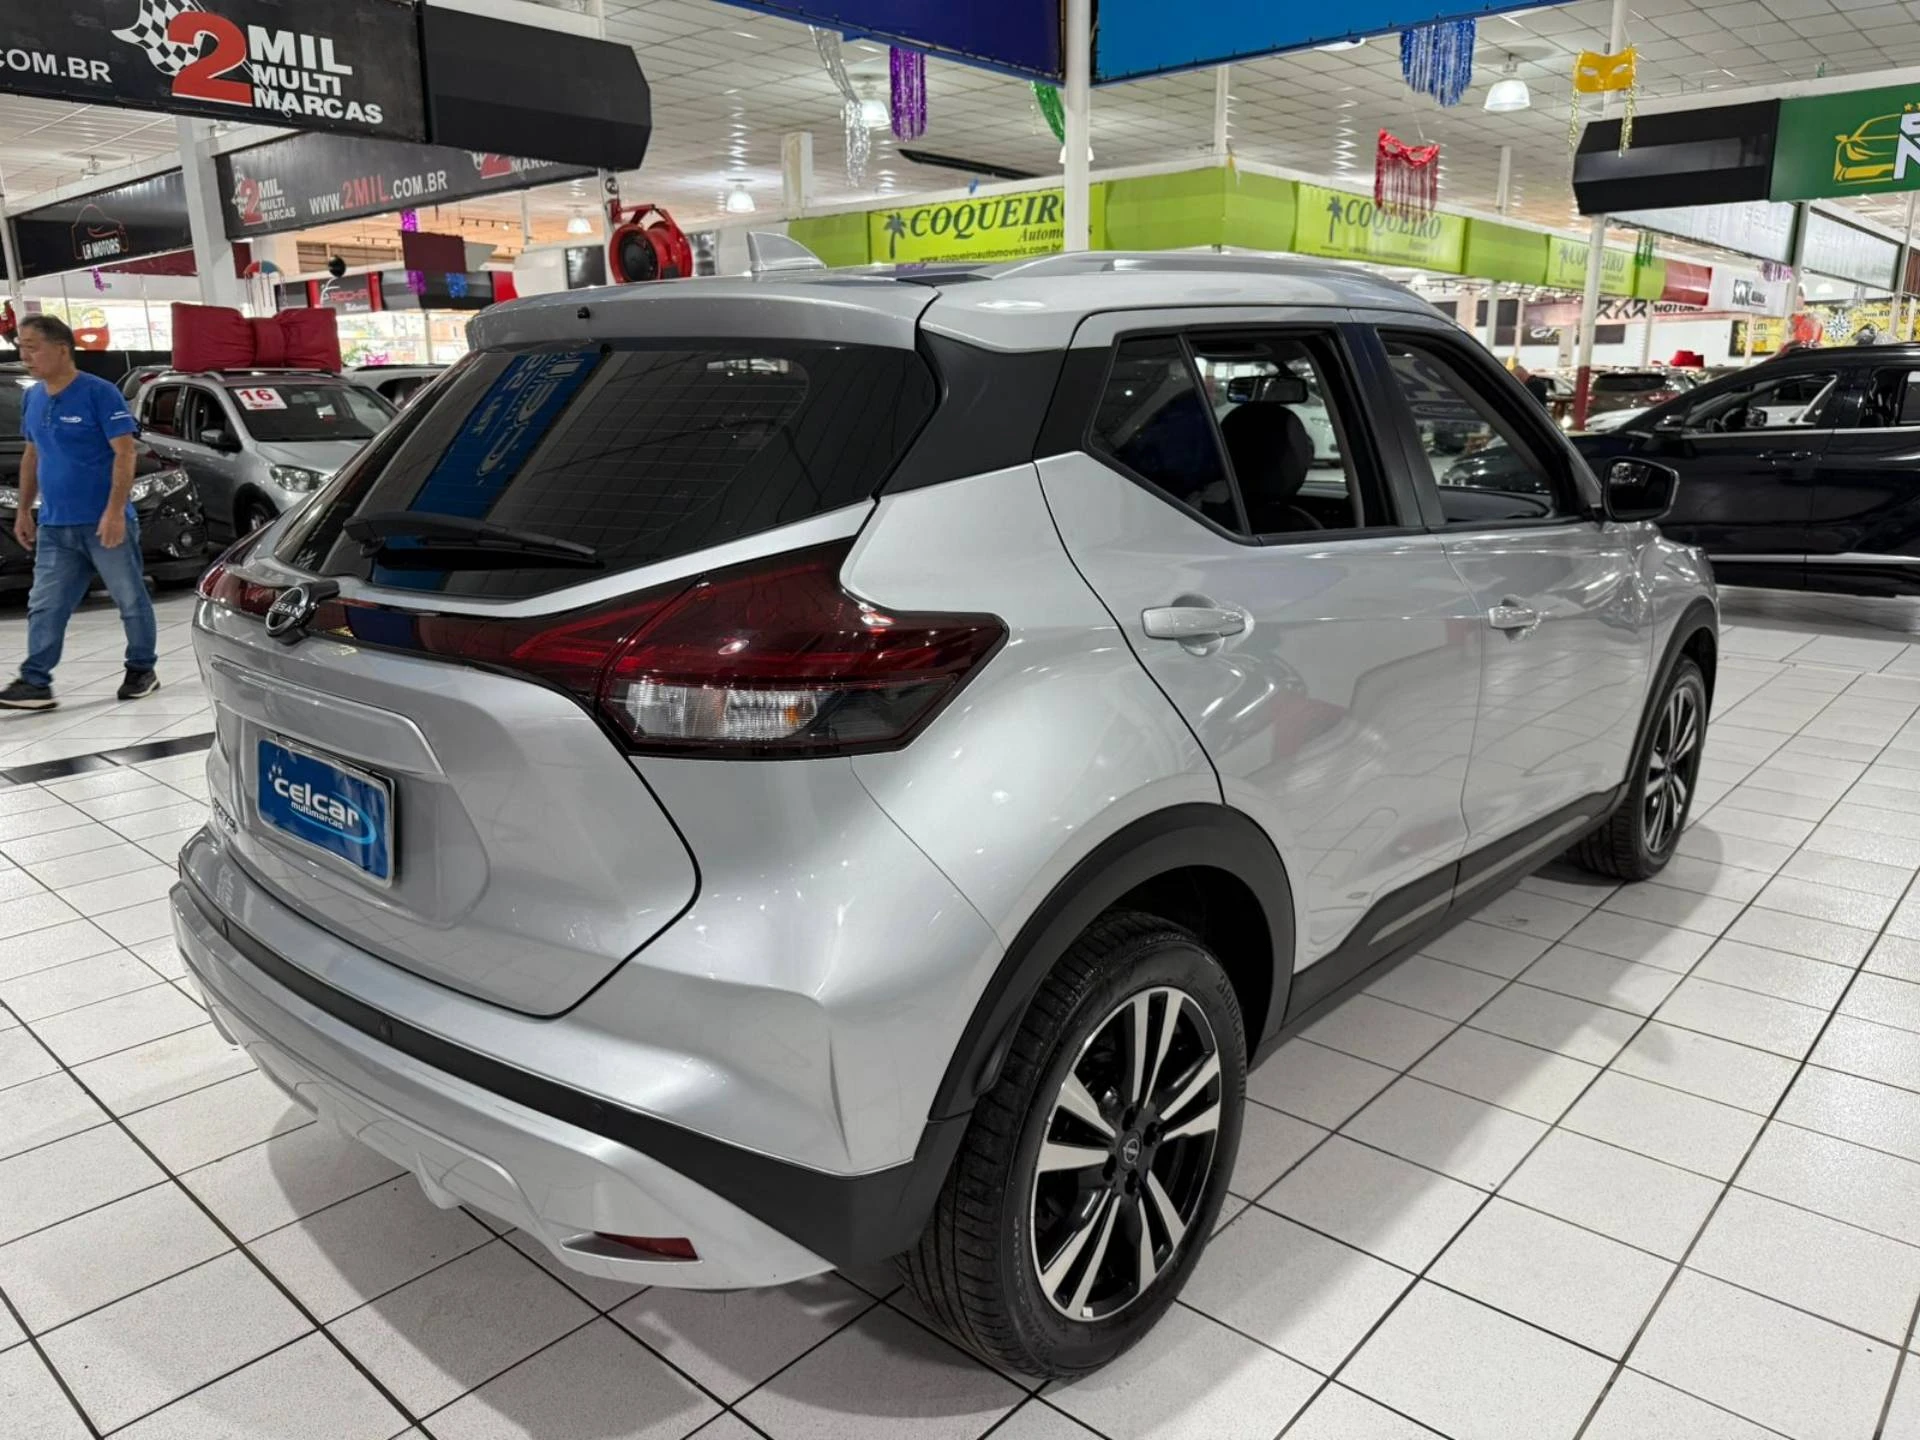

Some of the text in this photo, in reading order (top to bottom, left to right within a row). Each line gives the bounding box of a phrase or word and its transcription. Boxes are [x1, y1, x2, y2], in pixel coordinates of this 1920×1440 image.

[165, 11, 353, 107] 2 MIL
[253, 62, 341, 97] MULTI
[253, 87, 383, 125] MARCAS
[240, 178, 284, 226] 2 MIL
[260, 197, 287, 211] MULTI
[263, 207, 297, 222] MARCAS
[910, 194, 1065, 239] COQUEIR
[239, 389, 274, 401] 16
[273, 777, 359, 827] celcar
[290, 800, 344, 830] multimarcas
